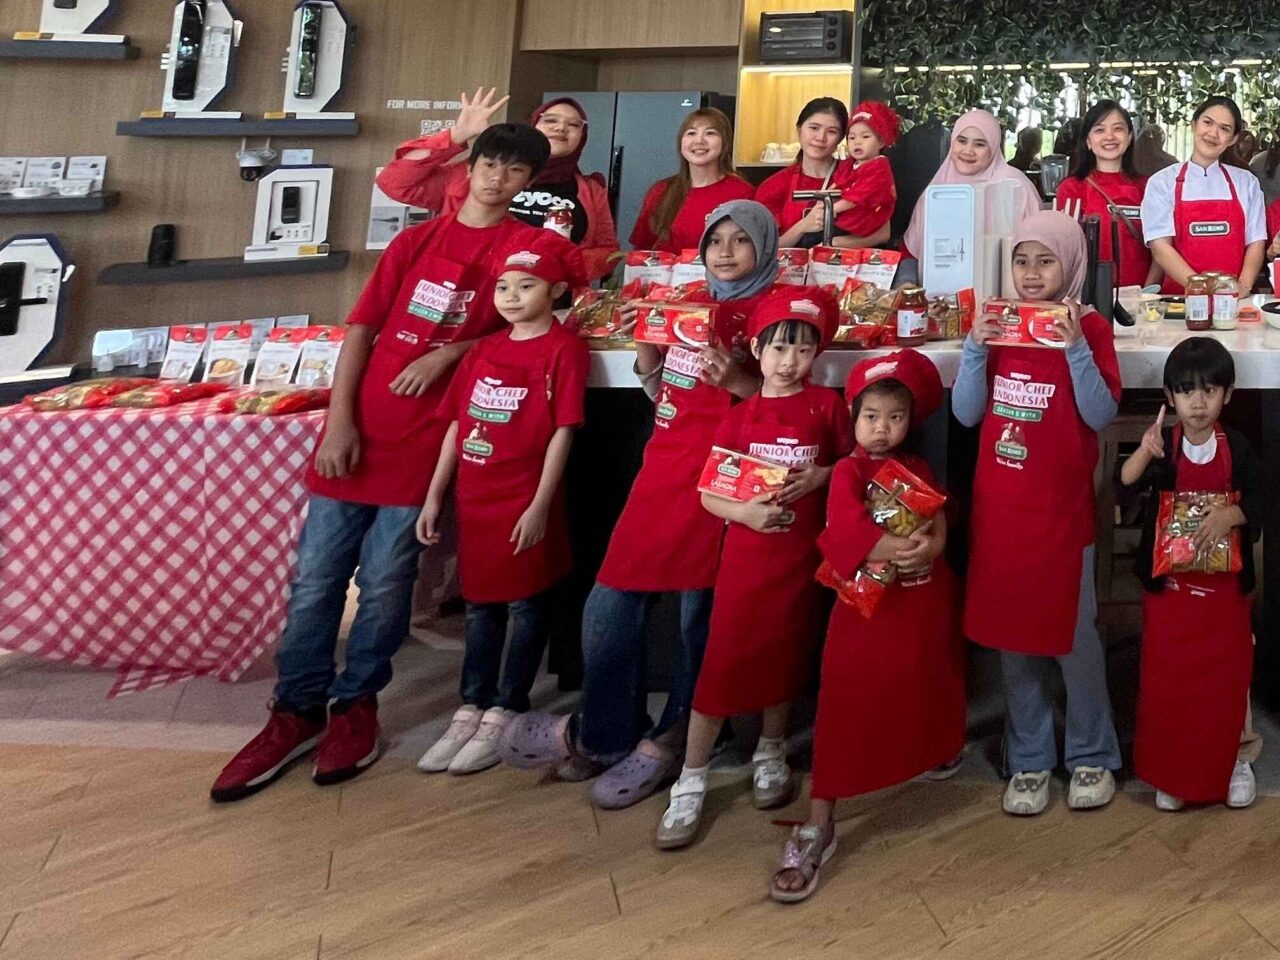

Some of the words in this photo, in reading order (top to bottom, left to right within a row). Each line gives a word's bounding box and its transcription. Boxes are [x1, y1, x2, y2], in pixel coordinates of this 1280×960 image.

[387, 100, 403, 109] FOR
[407, 100, 431, 110] MORE
[496, 388, 527, 398] CHEF
[1025, 384, 1054, 395] CHEF
[994, 388, 1047, 407] INDONESIA
[751, 445, 790, 457] JUNIOR
